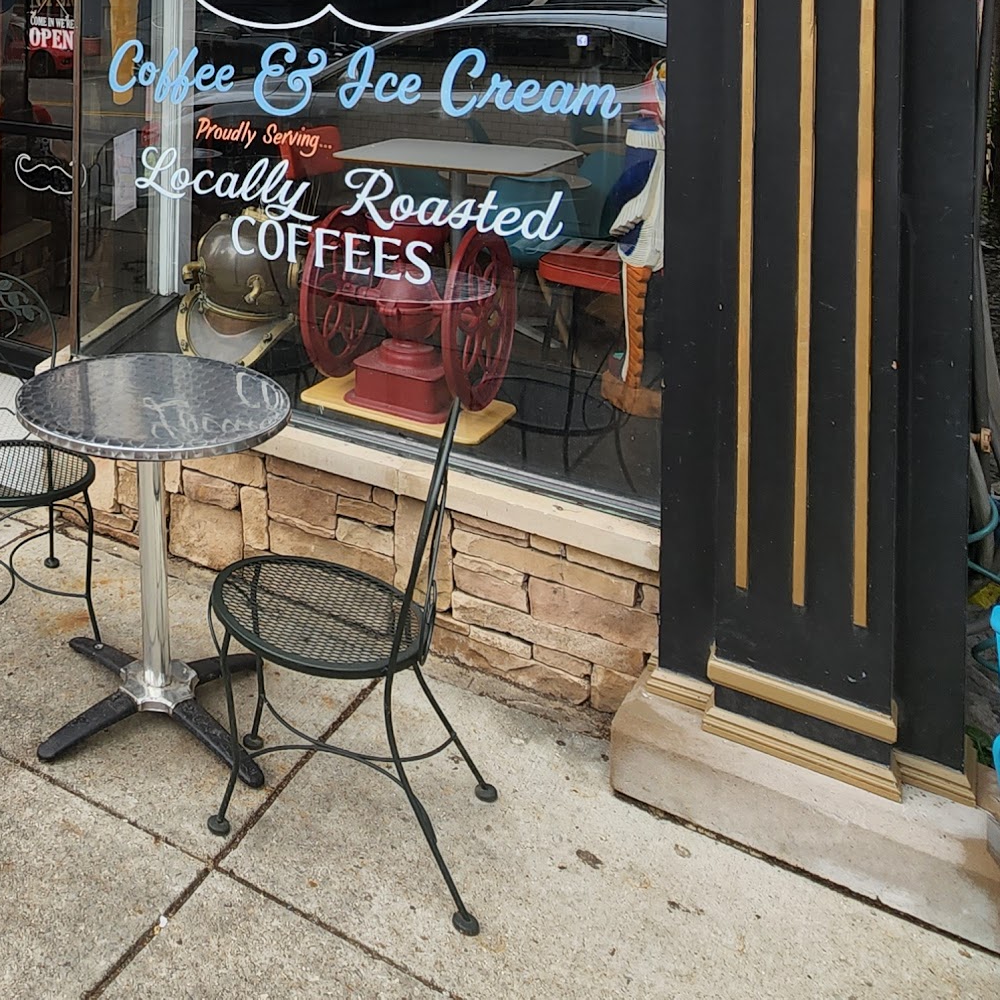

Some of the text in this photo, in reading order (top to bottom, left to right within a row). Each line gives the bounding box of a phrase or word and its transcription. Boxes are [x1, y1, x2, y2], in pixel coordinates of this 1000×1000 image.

[29, 26, 74, 50] OPEN
[47, 17, 55, 27] IN
[108, 39, 622, 119] Coffee & Ice Cream
[195, 117, 333, 158] Proudly Serving...
[135, 146, 319, 222] Locally
[343, 168, 564, 241] Roasted
[231, 215, 433, 287] COFFEES
